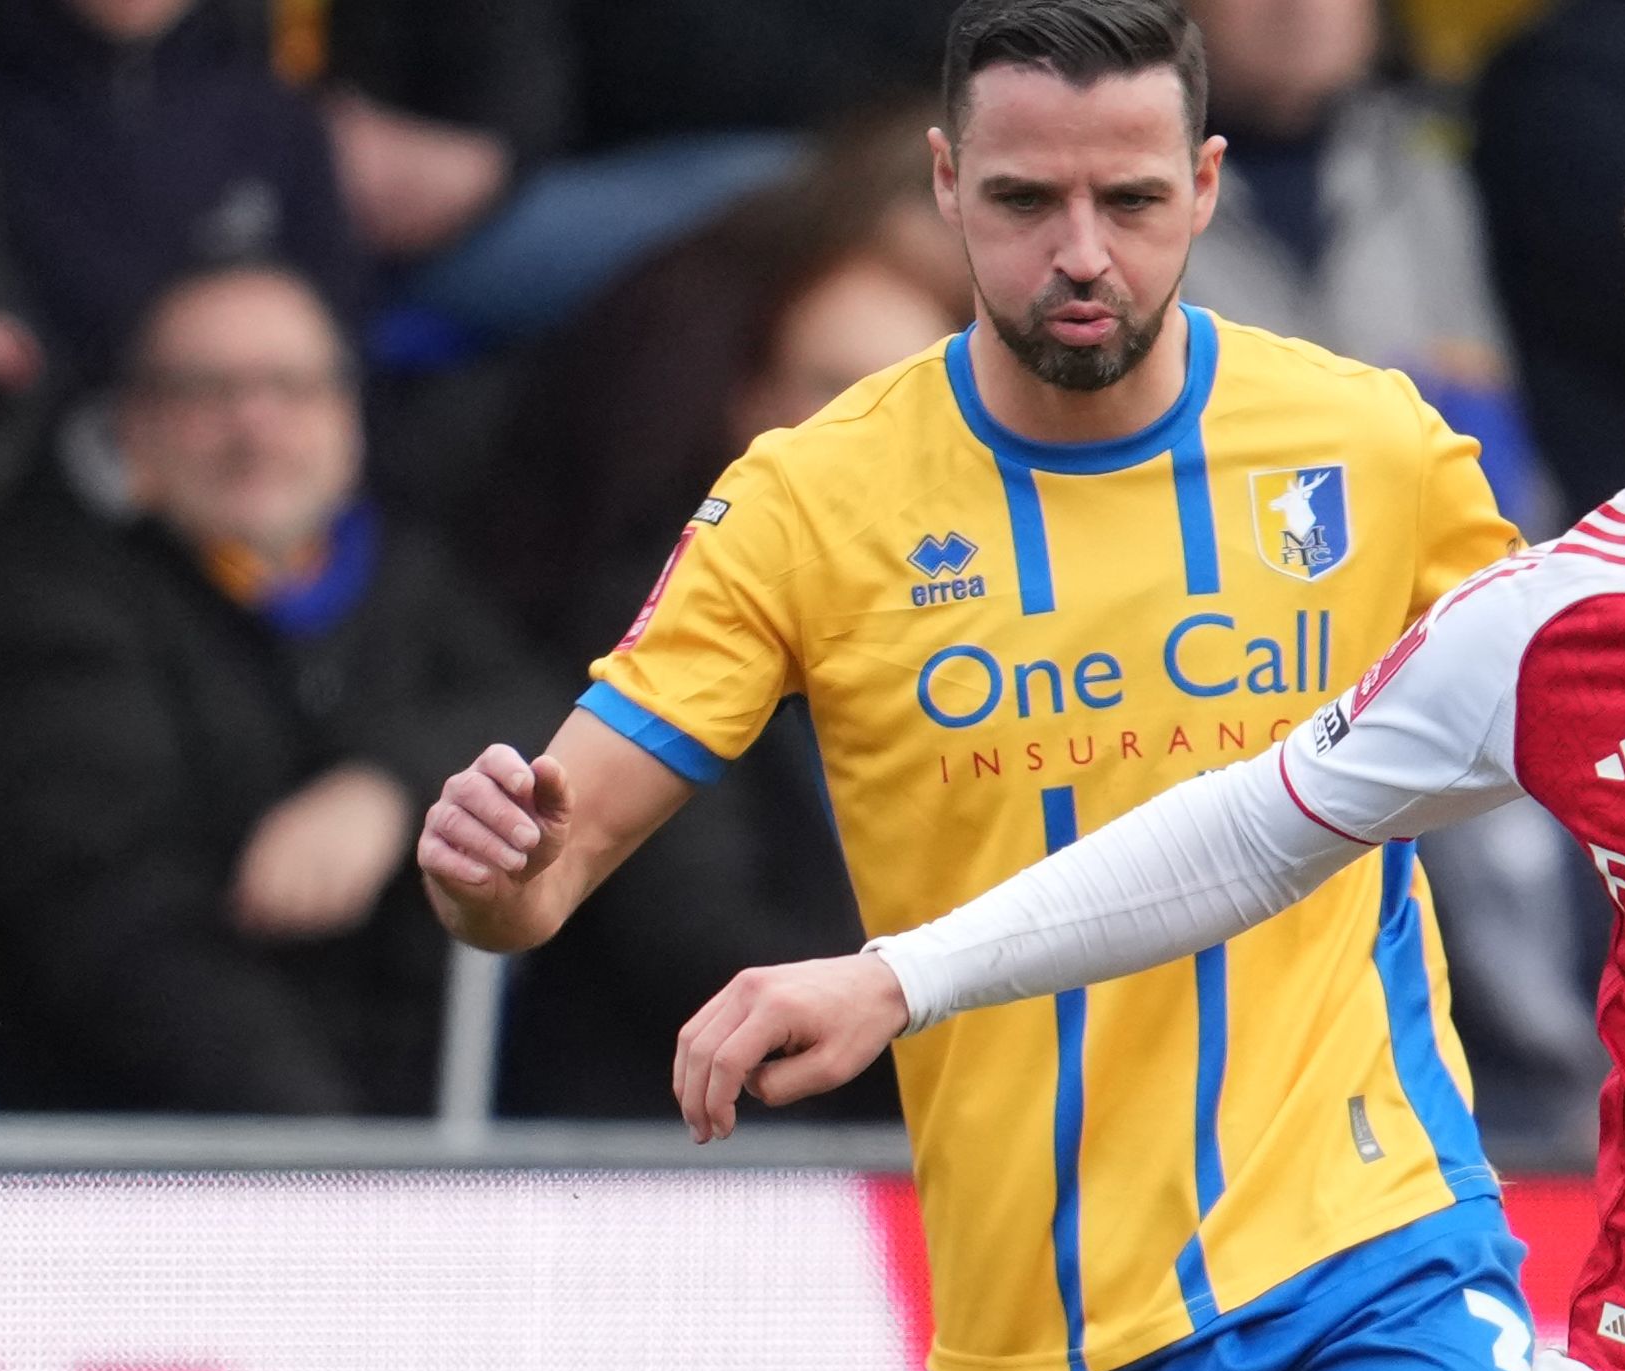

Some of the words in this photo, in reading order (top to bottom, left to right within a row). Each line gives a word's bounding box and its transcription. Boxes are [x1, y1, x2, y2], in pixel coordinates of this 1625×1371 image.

[910, 575, 986, 607] errea
[916, 643, 1125, 730] One
[1162, 609, 1332, 698] Call
[939, 718, 1293, 784] INSURANC
